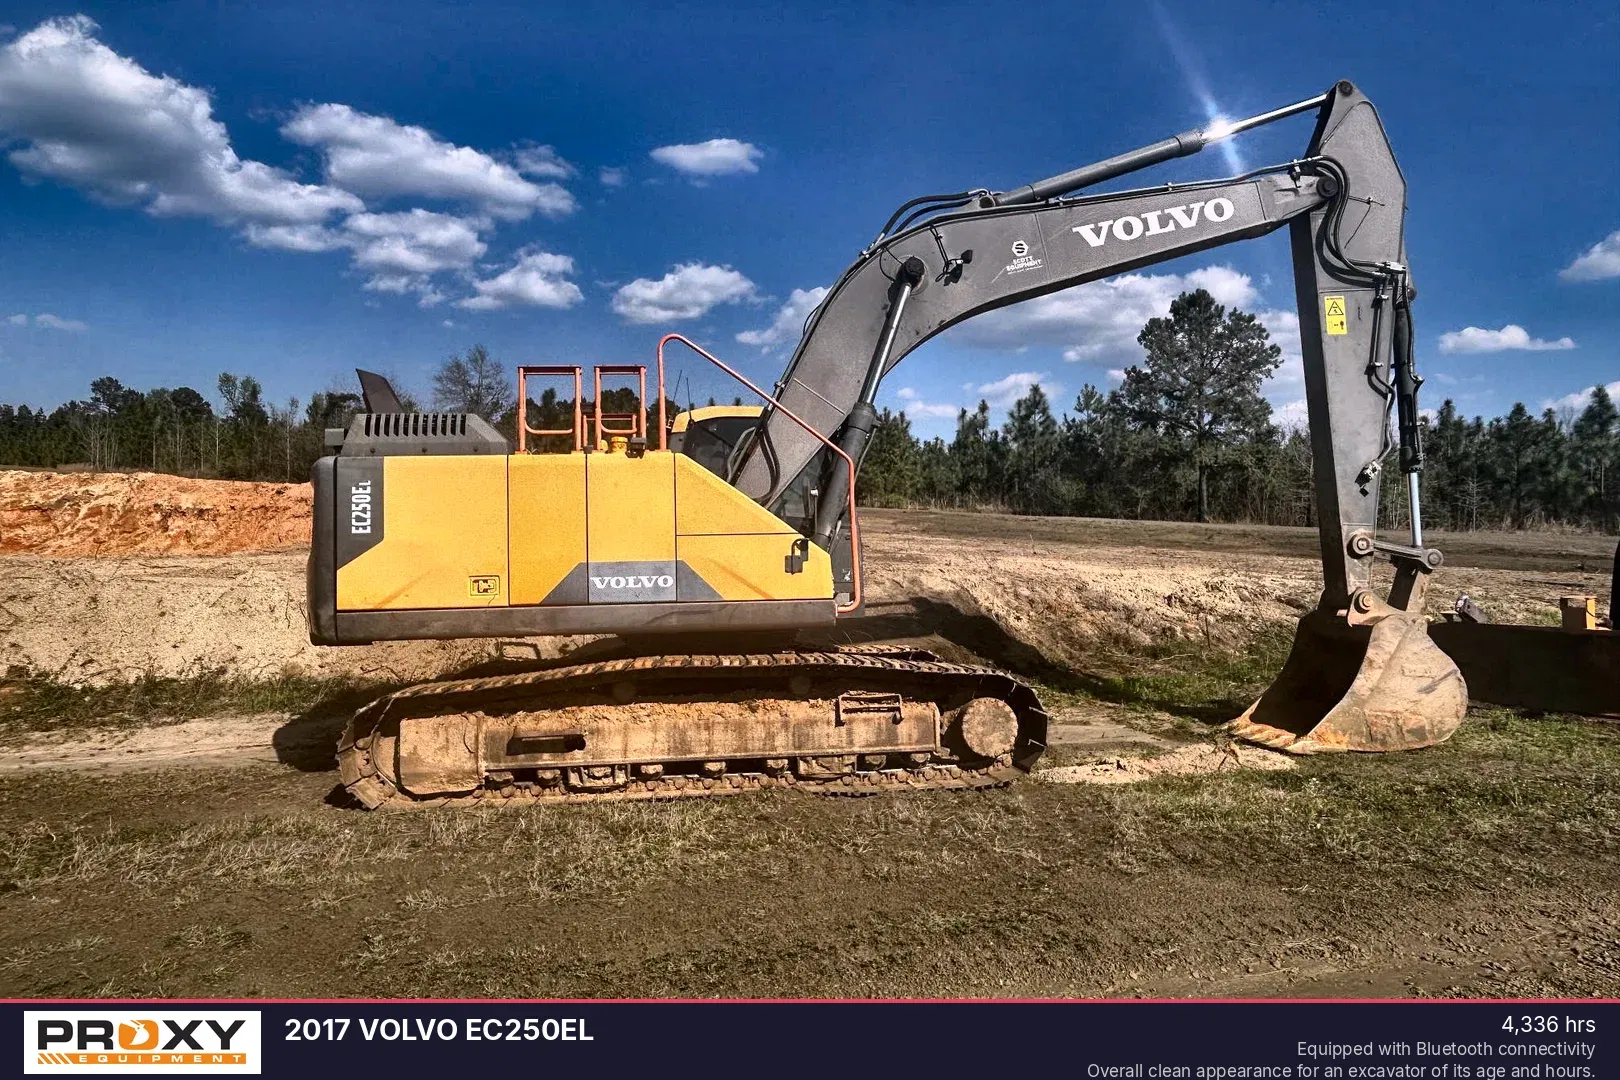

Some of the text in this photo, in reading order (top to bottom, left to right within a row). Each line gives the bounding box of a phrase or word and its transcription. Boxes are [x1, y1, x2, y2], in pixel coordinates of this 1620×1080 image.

[1072, 198, 1235, 248] VOLVO
[1006, 259, 1042, 271] EQUIPMENT
[1012, 255, 1034, 266] SCOTT
[590, 575, 674, 588] VOLVO
